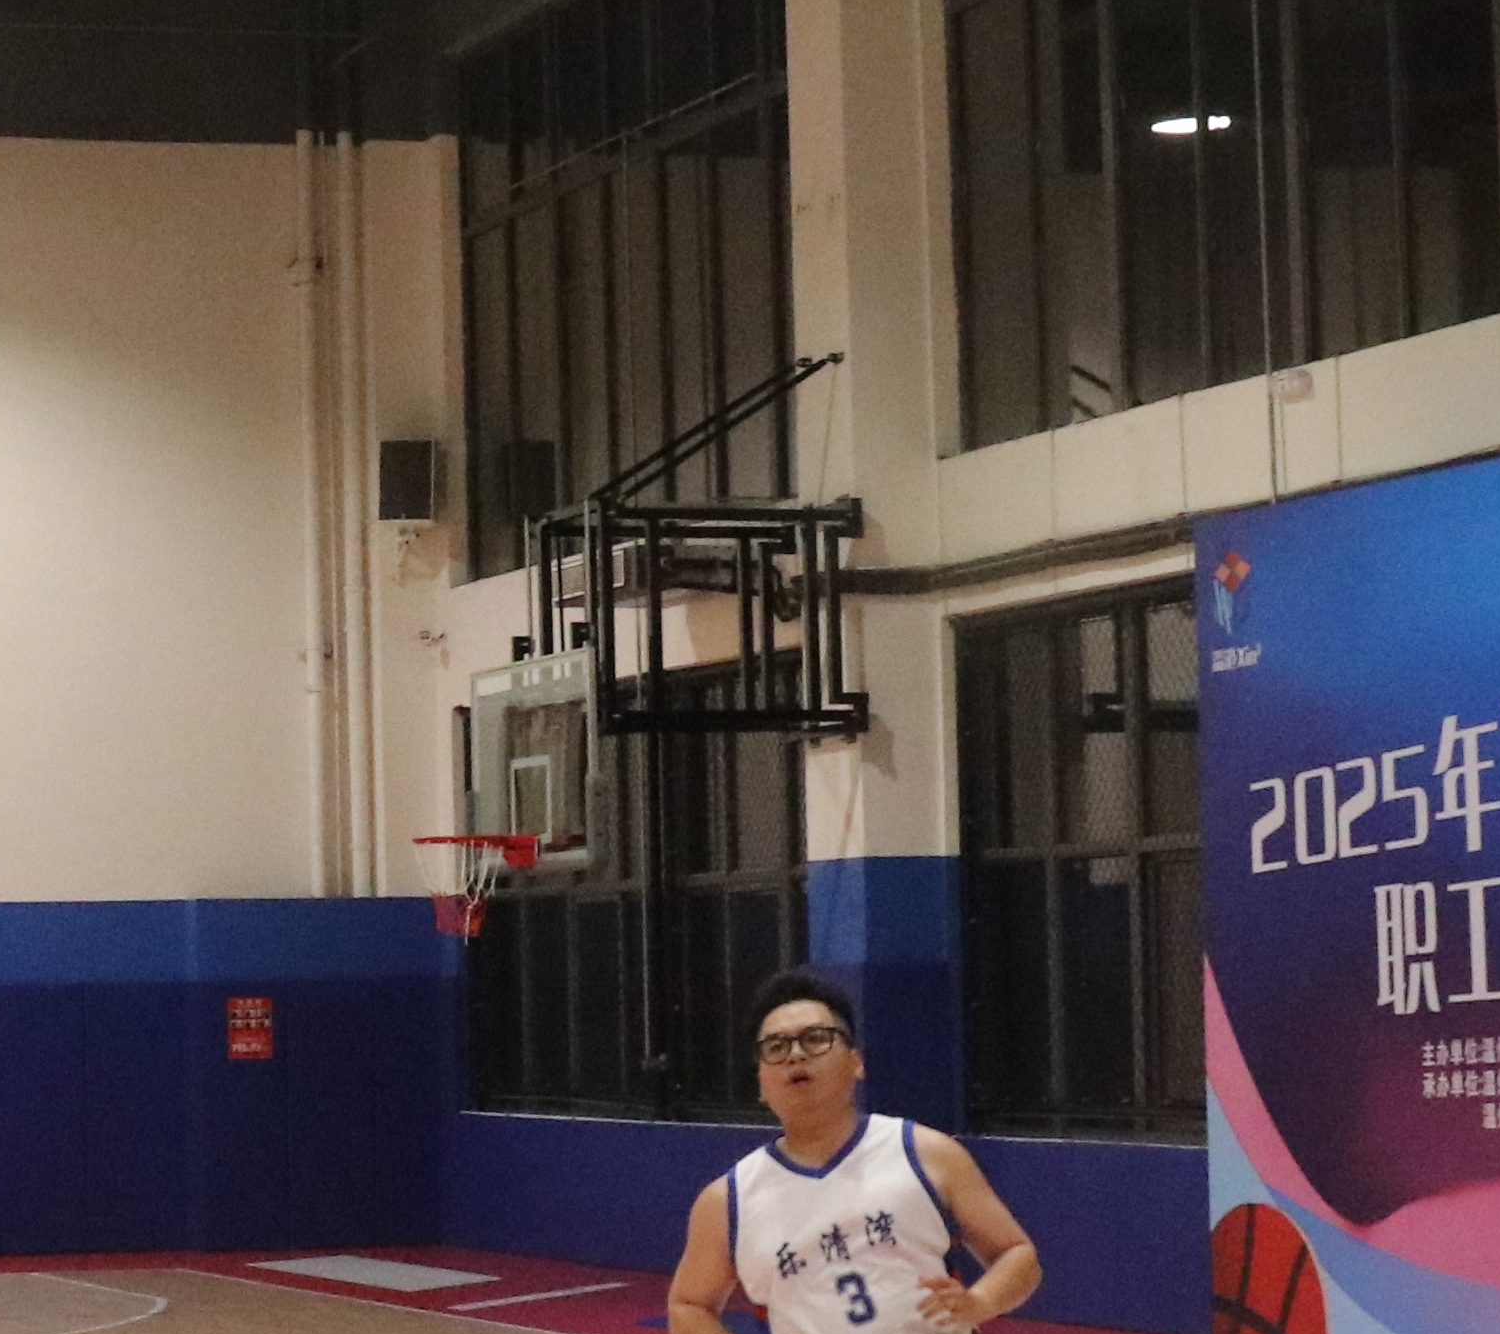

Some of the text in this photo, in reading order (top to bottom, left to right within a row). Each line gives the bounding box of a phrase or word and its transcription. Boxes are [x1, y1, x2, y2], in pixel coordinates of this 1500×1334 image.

[776, 1210, 898, 1279] 乐清湾
[835, 1271, 877, 1327] 3
